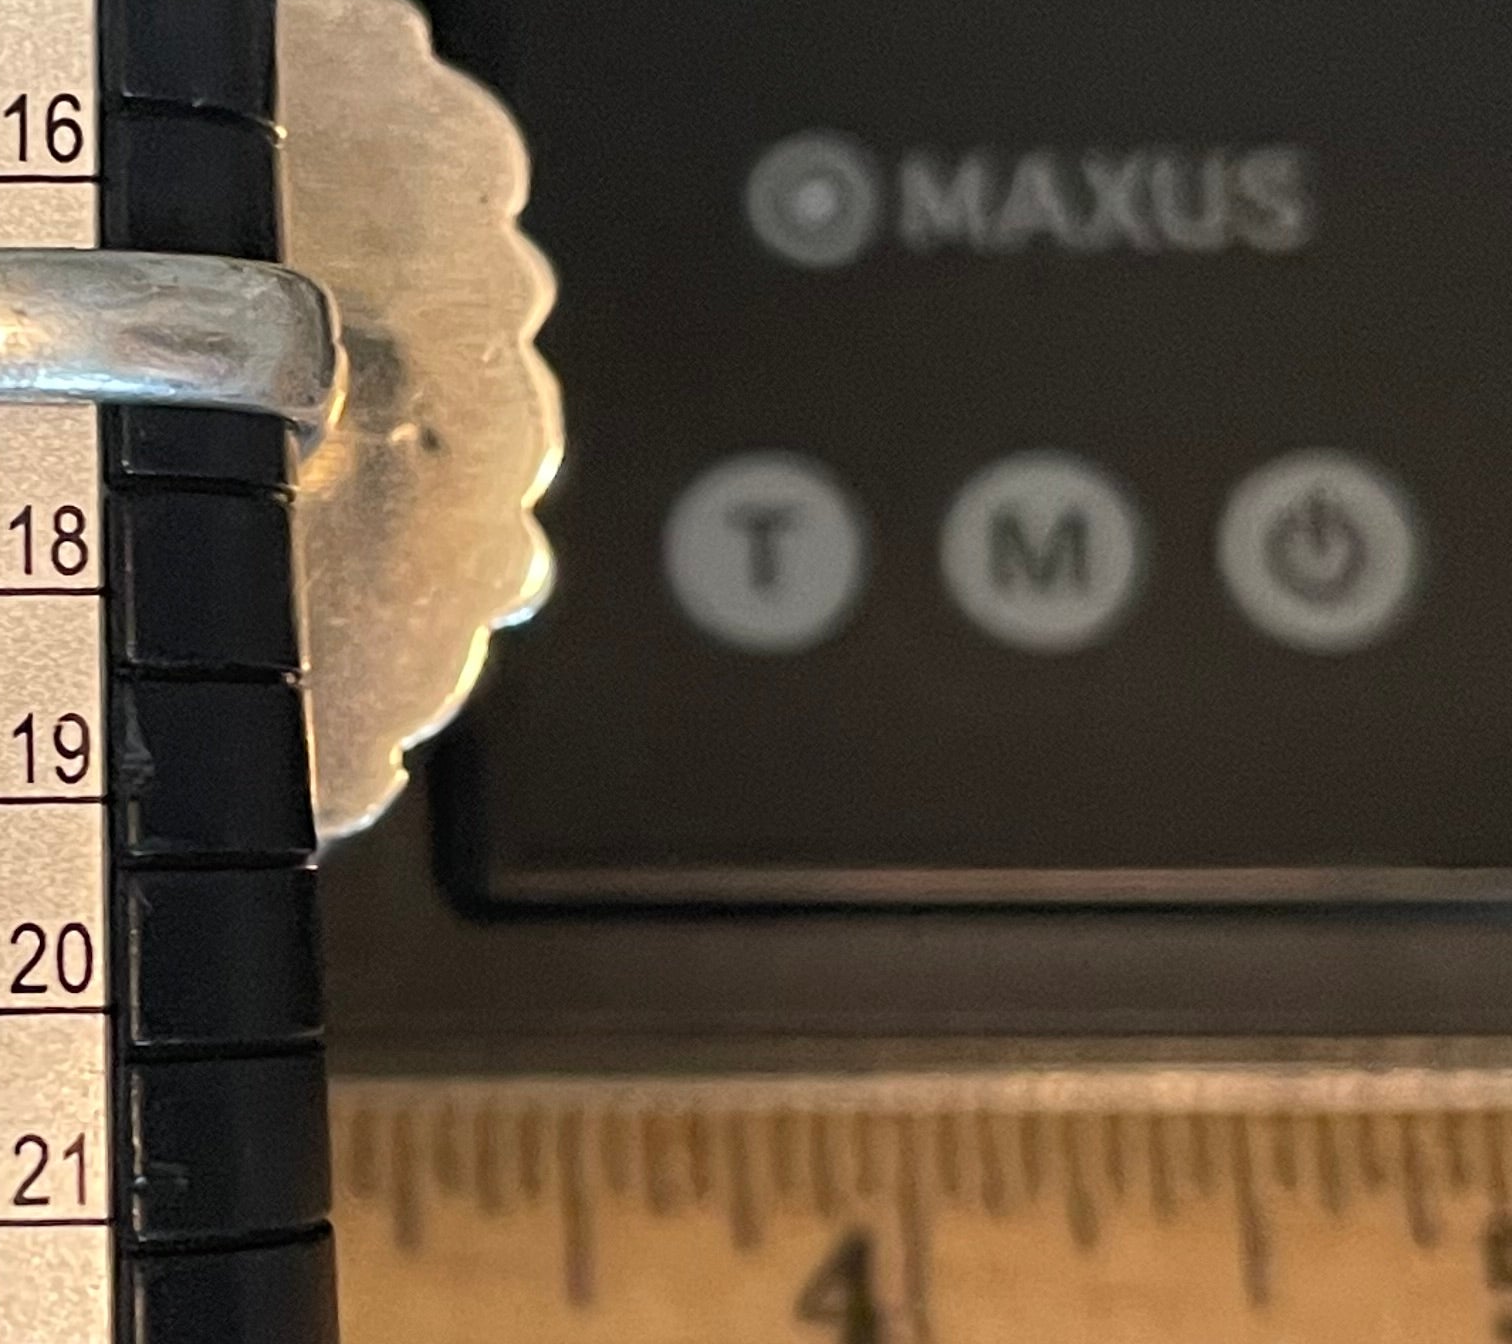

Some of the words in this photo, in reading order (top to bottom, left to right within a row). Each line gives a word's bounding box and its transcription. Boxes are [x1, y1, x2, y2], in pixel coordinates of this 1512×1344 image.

[2, 92, 85, 165] 16
[899, 145, 1312, 254] MAXUS
[8, 503, 90, 578] 18
[725, 500, 805, 596] T
[984, 500, 1091, 598] M
[11, 711, 92, 786] 19
[9, 921, 95, 995] 20
[11, 1132, 87, 1208] 21
